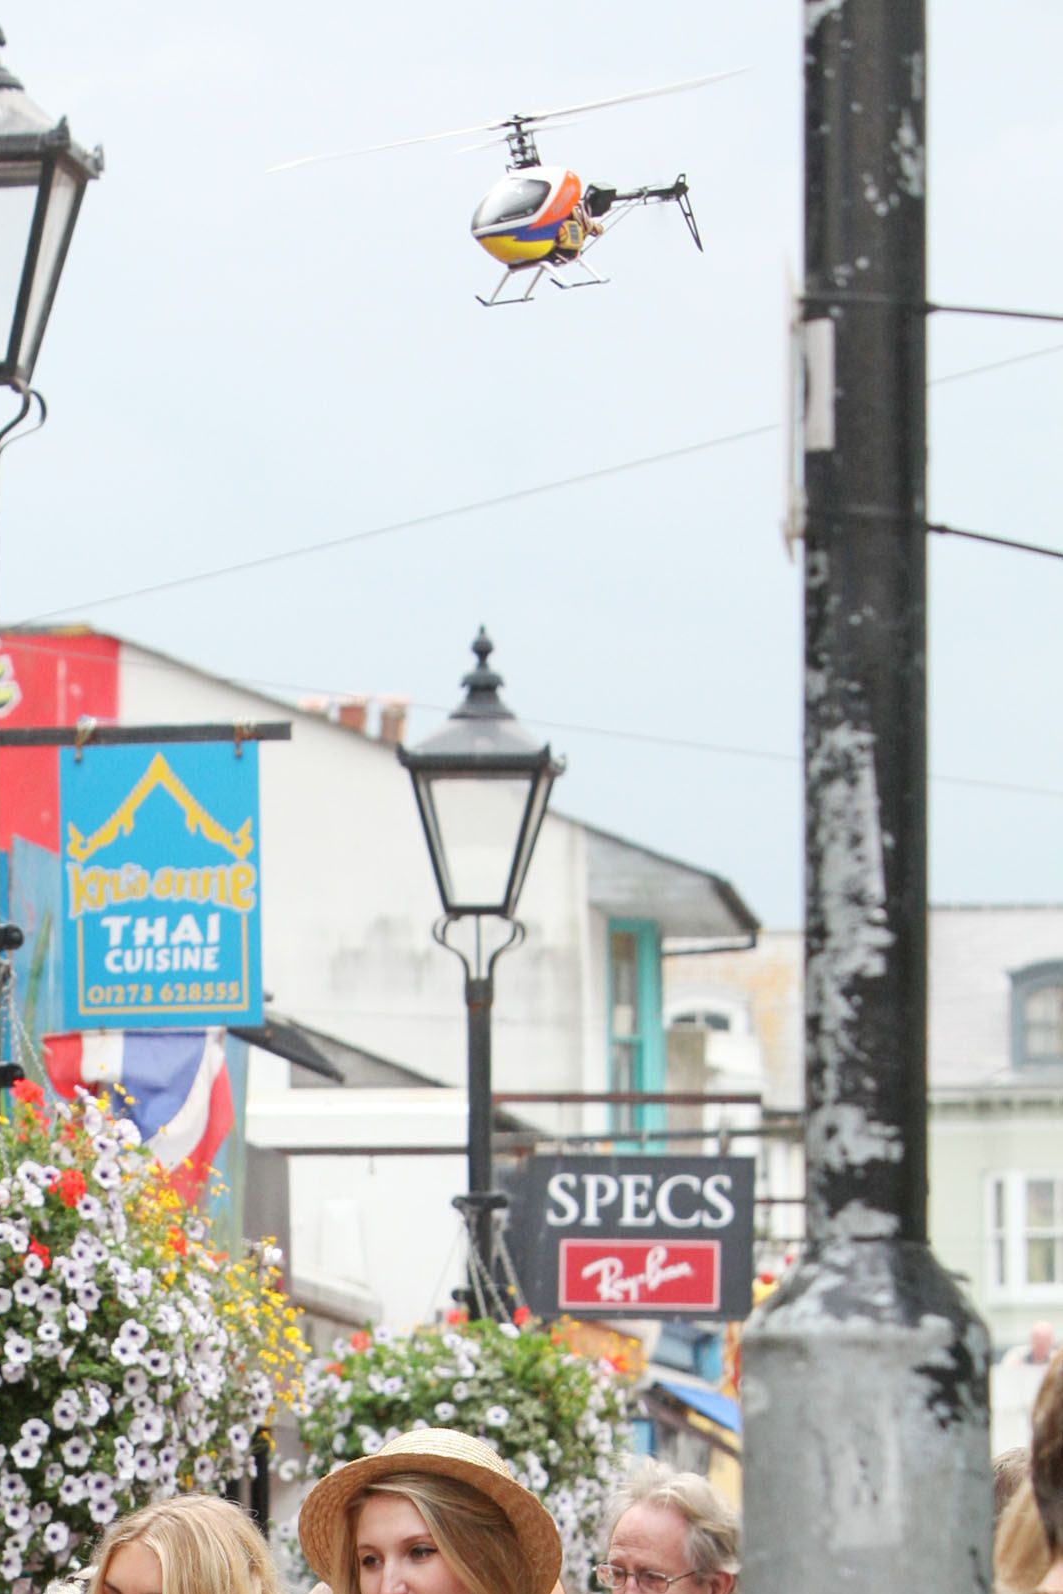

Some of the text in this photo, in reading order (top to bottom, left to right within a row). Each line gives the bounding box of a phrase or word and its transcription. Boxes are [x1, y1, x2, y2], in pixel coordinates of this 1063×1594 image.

[100, 912, 221, 947] THAI
[104, 945, 220, 973] CUISINE
[87, 984, 153, 1004] 01273
[546, 1172, 735, 1229] SPECS
